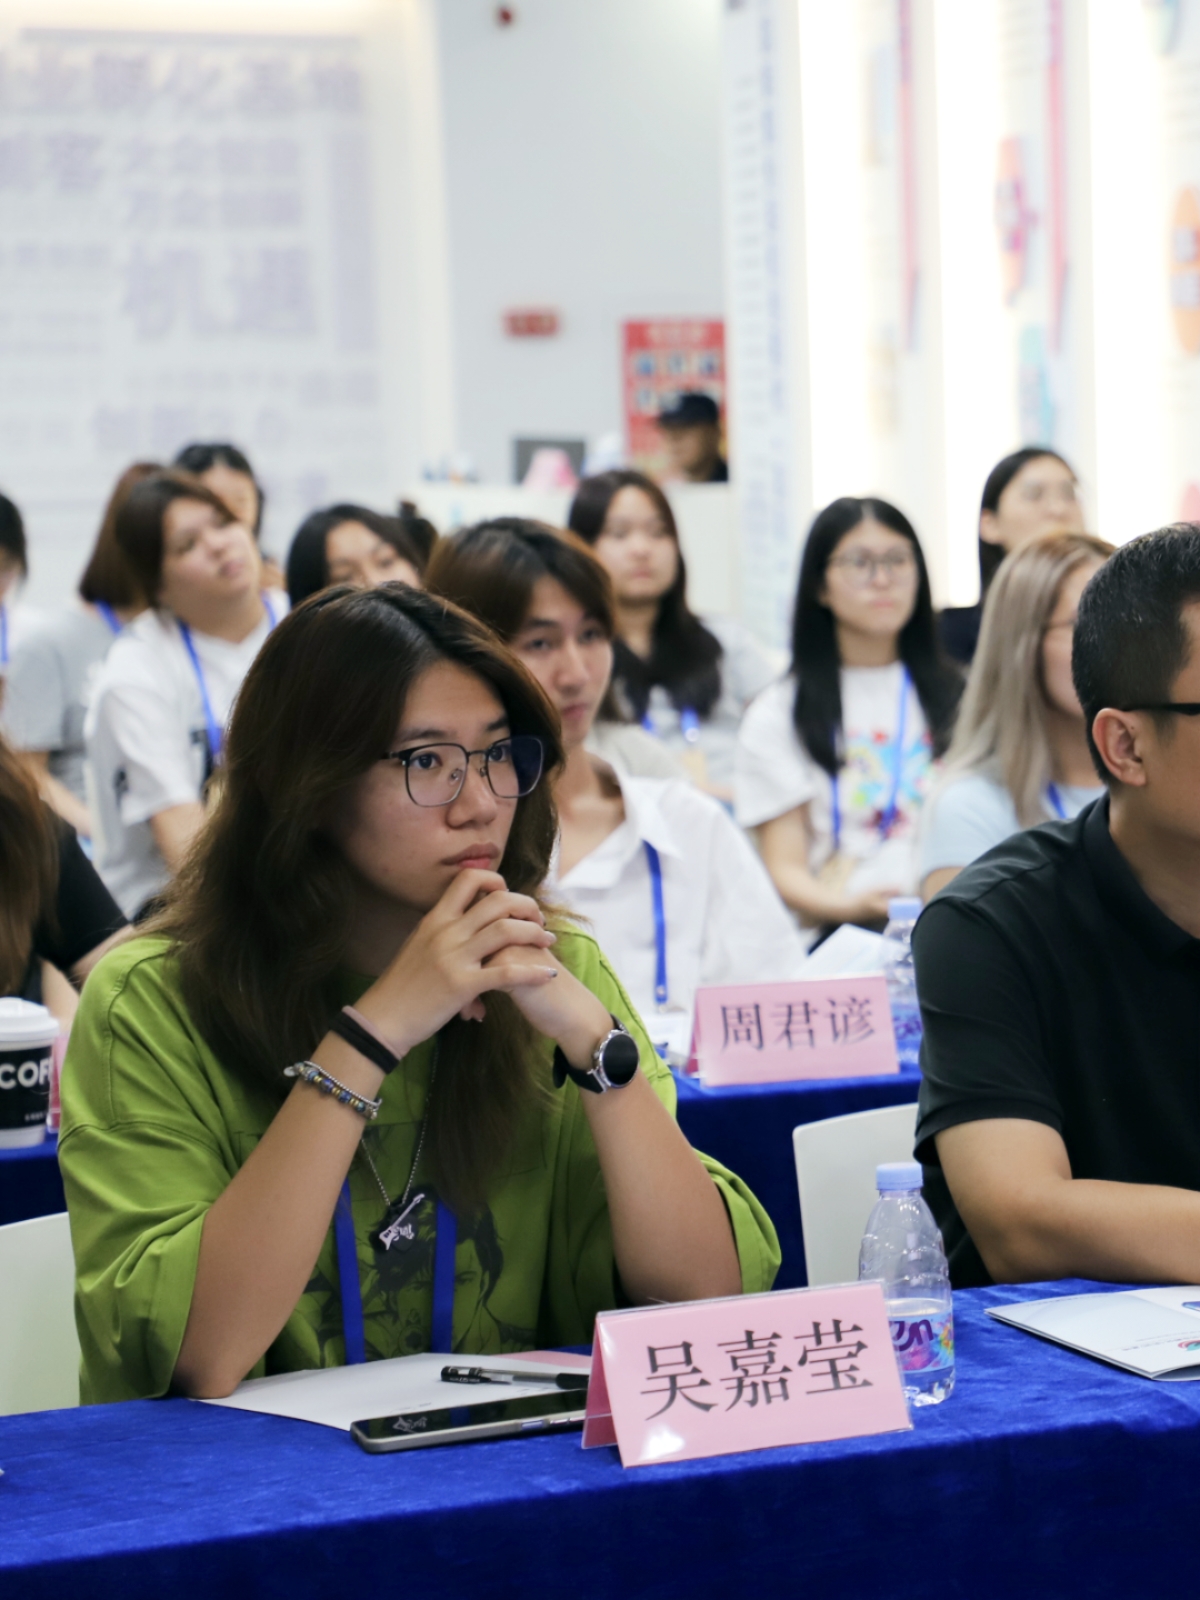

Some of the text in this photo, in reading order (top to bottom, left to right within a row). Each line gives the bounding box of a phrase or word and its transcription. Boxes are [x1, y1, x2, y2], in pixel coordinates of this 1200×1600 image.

[720, 996, 876, 1053] 周君谚
[640, 1317, 875, 1422] 吴嘉莹
